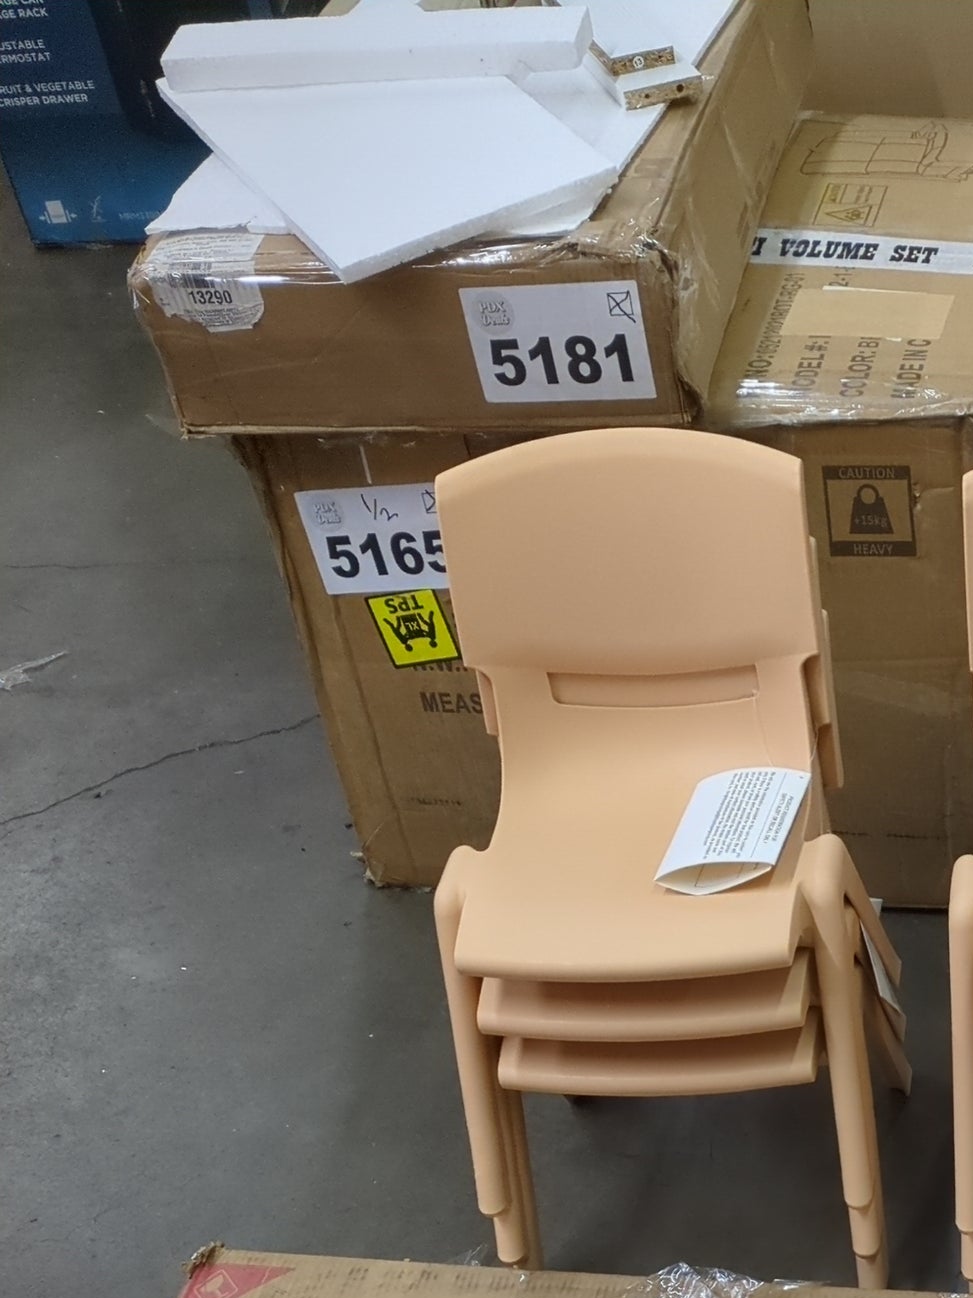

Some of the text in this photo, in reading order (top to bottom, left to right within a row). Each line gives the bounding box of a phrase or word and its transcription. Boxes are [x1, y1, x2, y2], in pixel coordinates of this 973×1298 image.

[17, 8, 49, 17] RACK
[24, 84, 33, 93] &
[33, 80, 95, 92] VEGETABLE
[41, 93, 88, 104] DRAWER
[779, 238, 879, 260] VOLUME
[889, 245, 939, 264] SET
[189, 290, 233, 305] 13290
[489, 334, 634, 387] 5181
[838, 468, 895, 479] CAUTION
[326, 530, 447, 578] 5165
[853, 544, 893, 555] HEAVY
[384, 594, 424, 615] TPS
